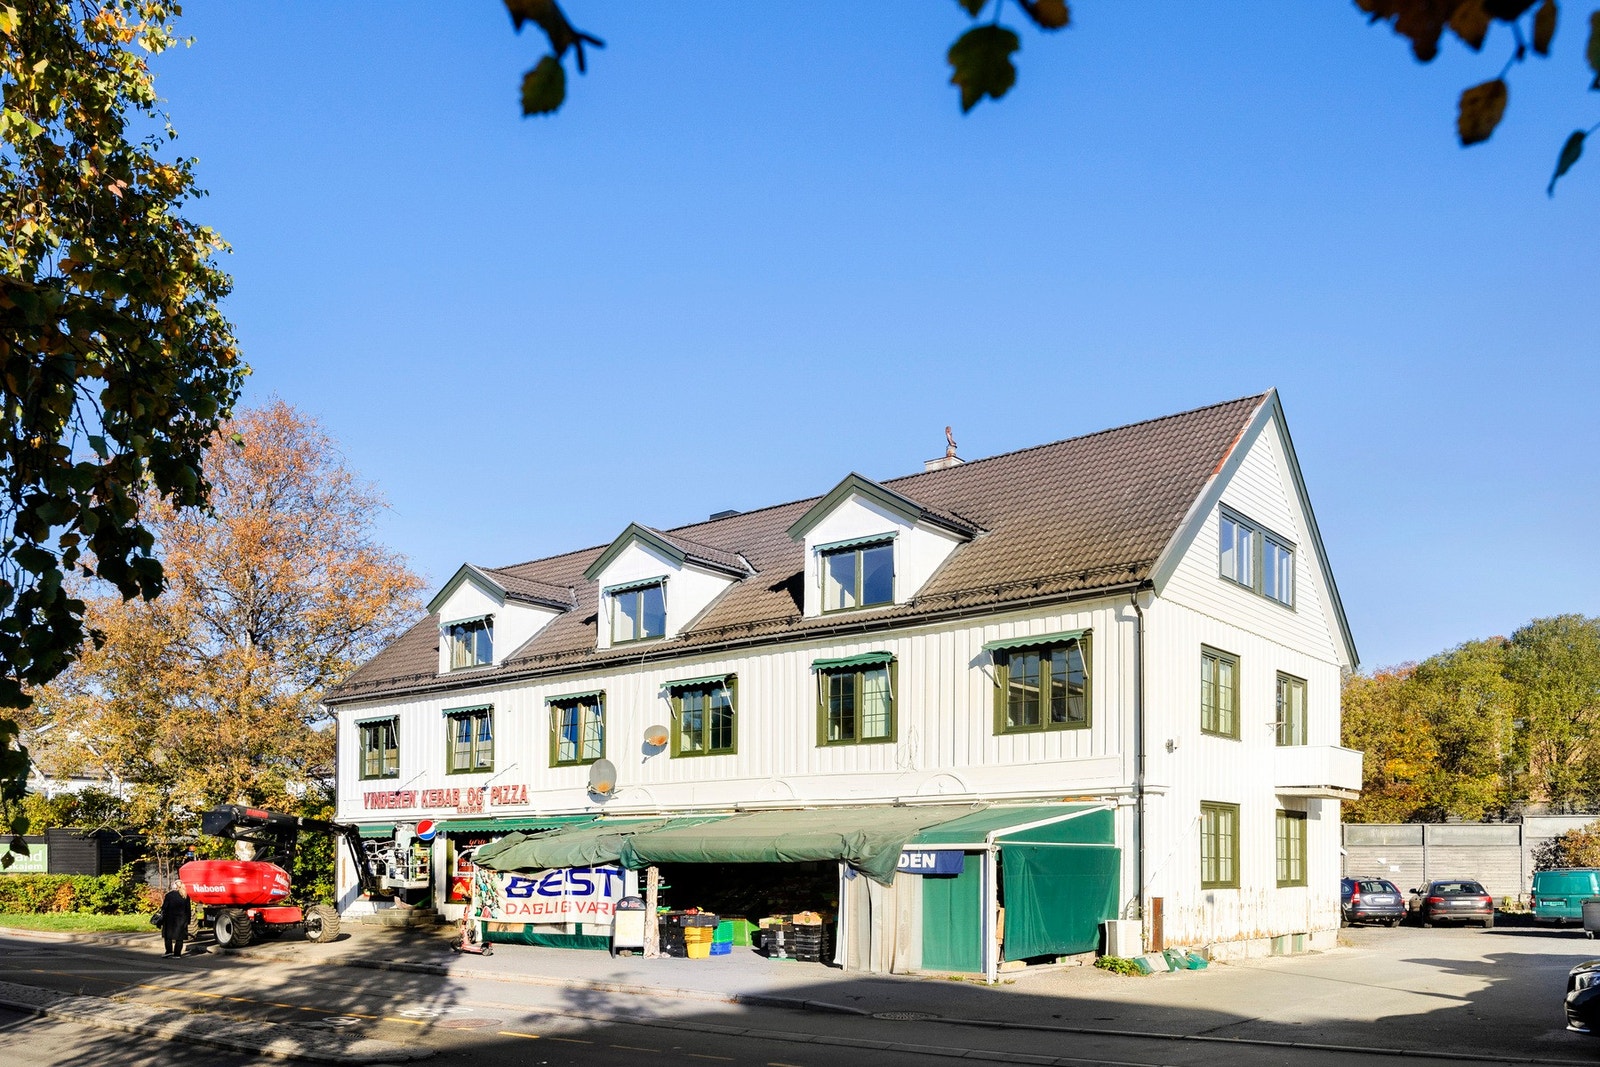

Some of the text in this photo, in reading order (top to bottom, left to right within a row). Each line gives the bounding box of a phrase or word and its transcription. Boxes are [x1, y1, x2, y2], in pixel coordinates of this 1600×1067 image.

[363, 784, 529, 810] VINDEREN KEBAB OG PIZZA
[897, 853, 936, 869] DEN
[192, 884, 226, 894] Naboen
[505, 866, 622, 898] BEST
